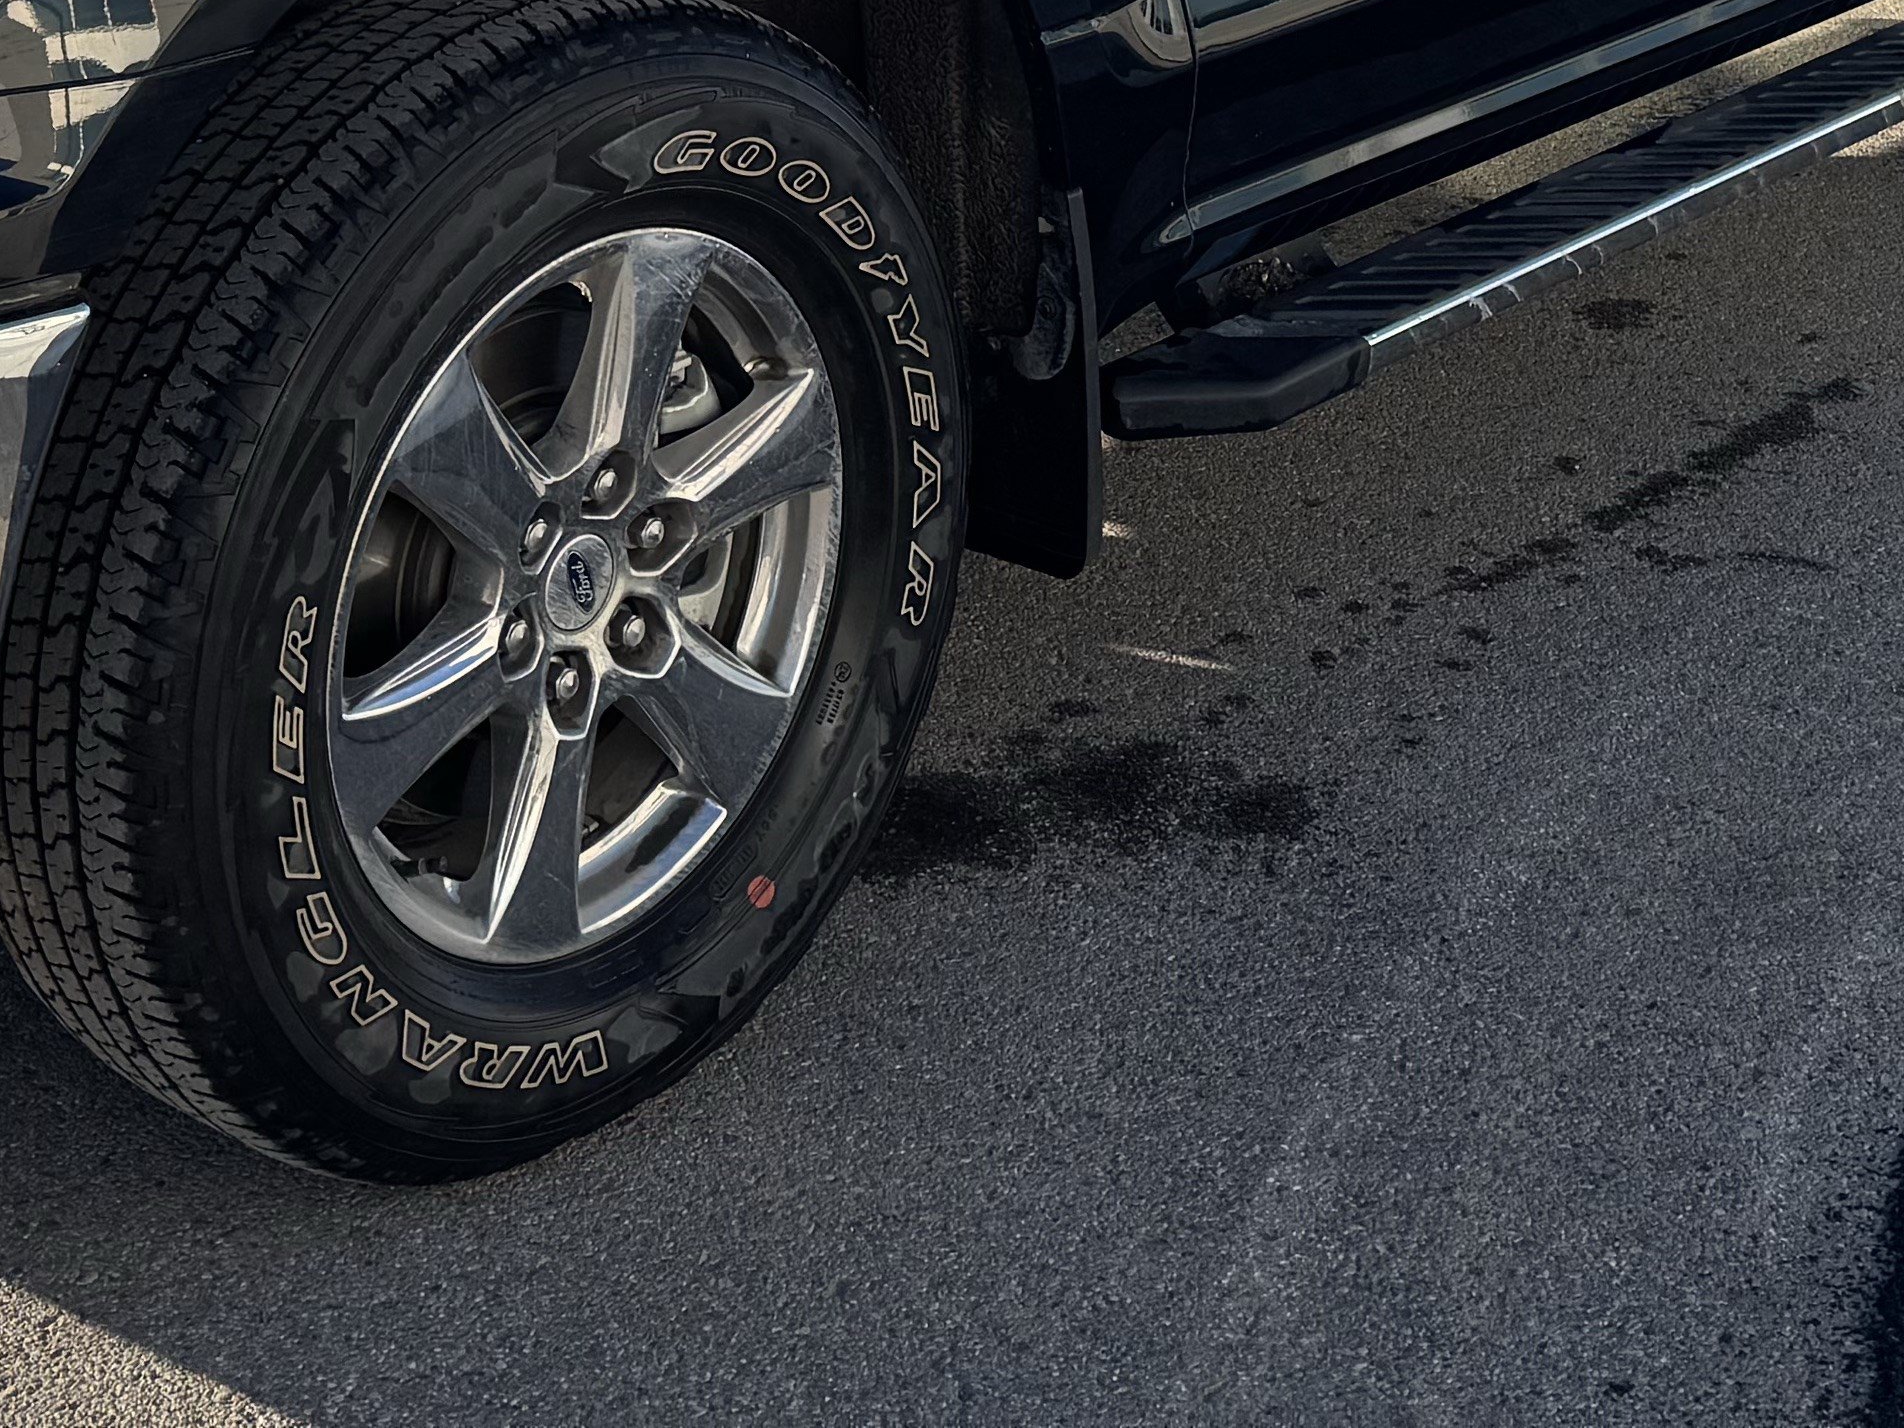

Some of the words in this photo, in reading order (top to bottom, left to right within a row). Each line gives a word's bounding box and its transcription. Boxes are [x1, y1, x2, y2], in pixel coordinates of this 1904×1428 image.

[571, 561, 594, 603] Ford
[653, 129, 943, 628] GOODYEAR
[272, 593, 609, 1091] WRANGLER
